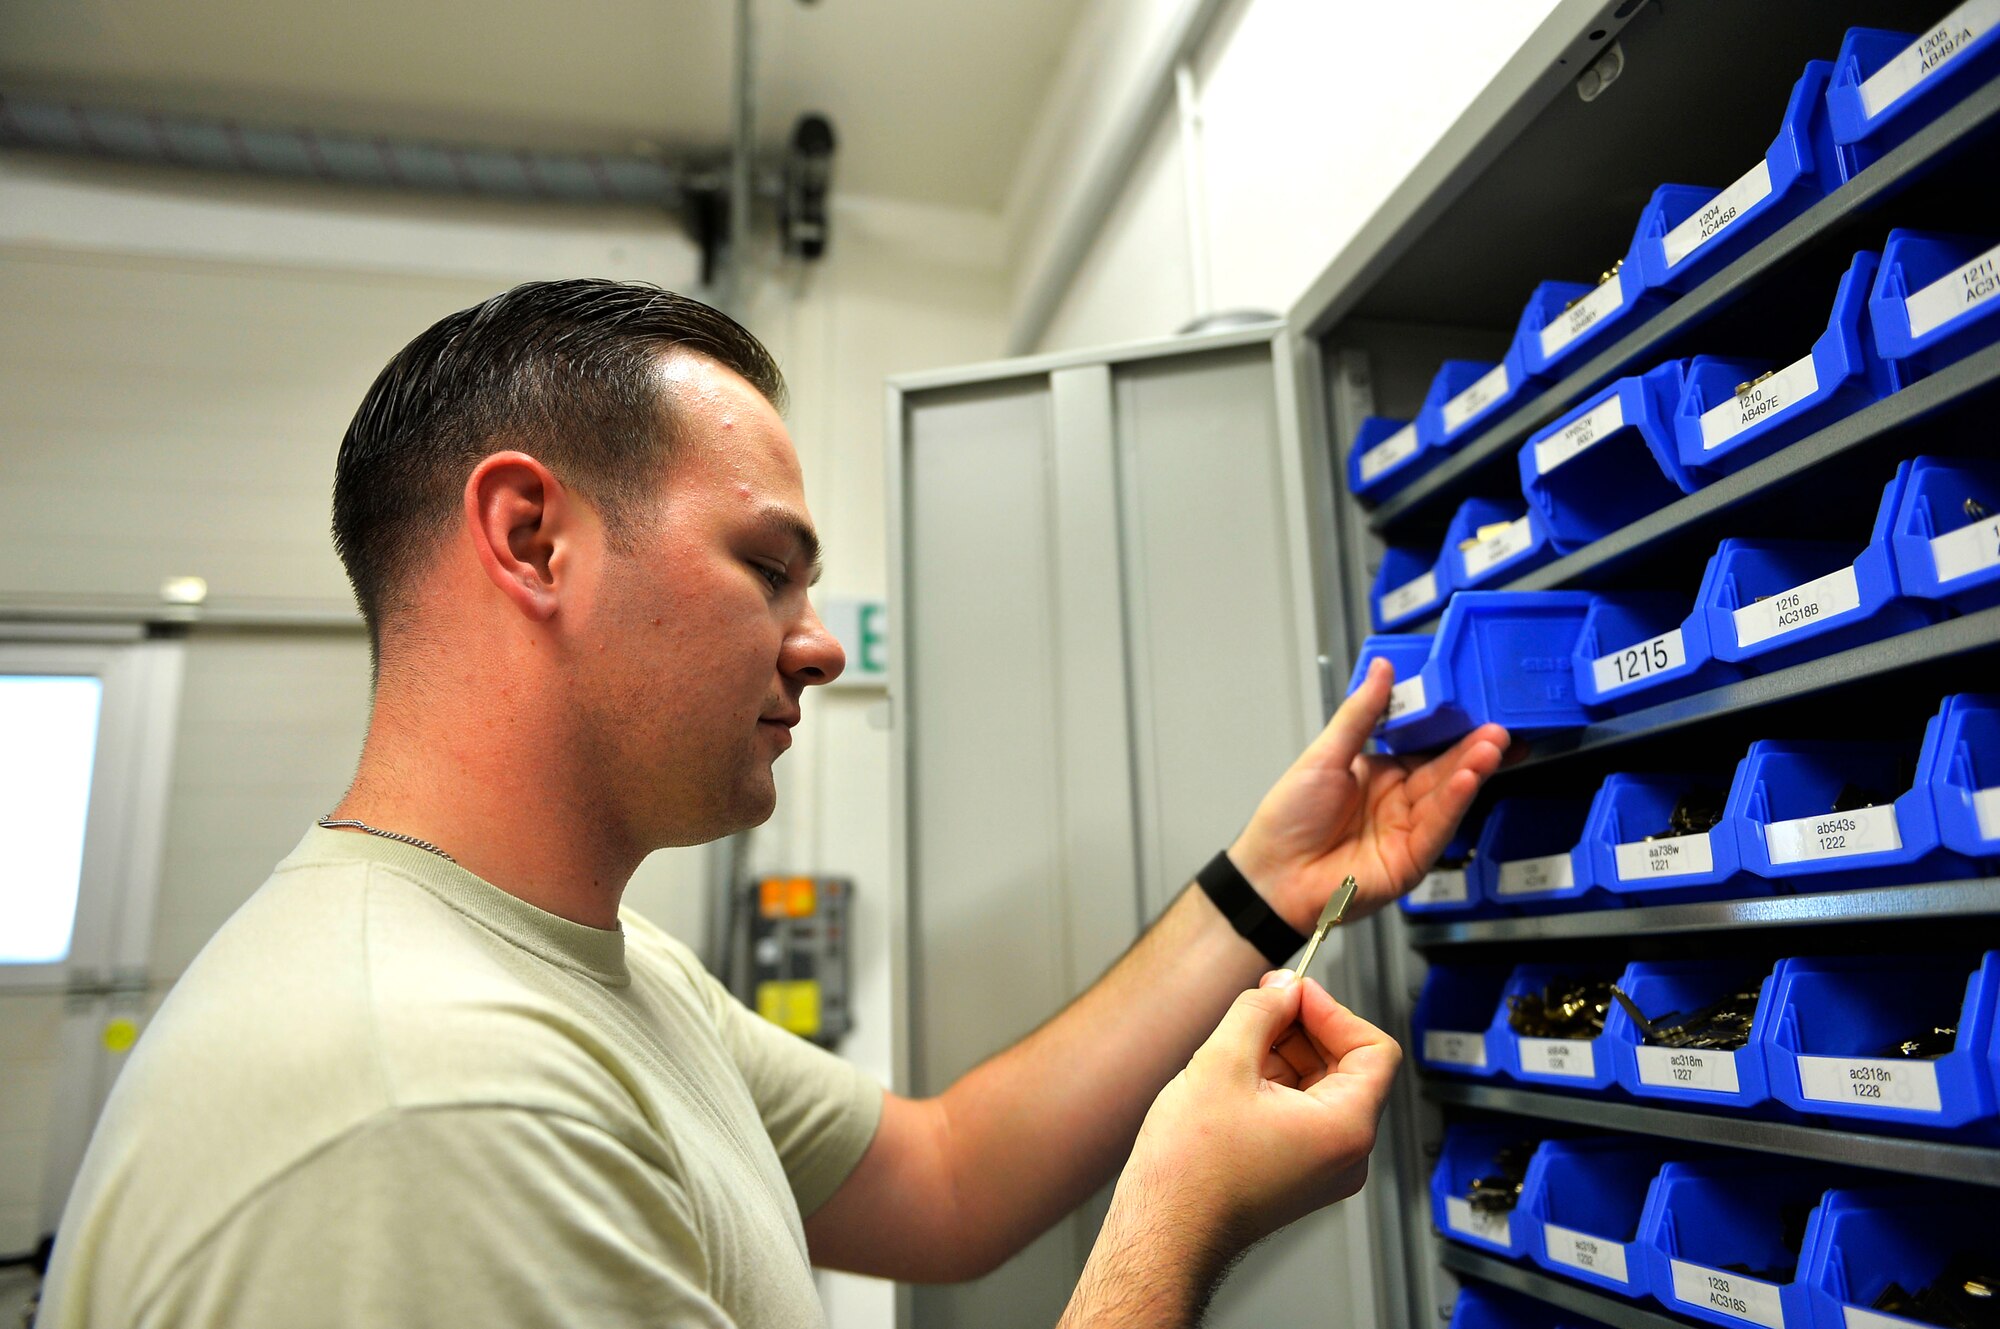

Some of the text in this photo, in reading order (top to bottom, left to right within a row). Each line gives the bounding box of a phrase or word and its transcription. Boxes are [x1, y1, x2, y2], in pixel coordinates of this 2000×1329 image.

[1917, 28, 1948, 57] 1205
[1921, 28, 1972, 74] AB497A
[1699, 205, 1720, 227] 1204
[1701, 207, 1737, 240] AC445B
[1962, 259, 1993, 285] 1211
[1740, 390, 1762, 410] 1210
[1741, 395, 1779, 424] AB497E
[1776, 594, 1800, 612] 1216
[1778, 603, 1819, 627] AC318B
[1614, 639, 1668, 682] 1215
[1817, 818, 1856, 835] ab543s
[1649, 844, 1680, 857] aa738w
[1819, 836, 1846, 850] 1222
[1651, 859, 1669, 871] 1221
[1670, 1055, 1703, 1067] ac318m
[1673, 1069, 1692, 1081] 1227
[1850, 1067, 1892, 1082] ac318n
[1852, 1083, 1881, 1098] 1228
[1708, 1276, 1730, 1292] 1233
[1710, 1292, 1747, 1314] AC318S
